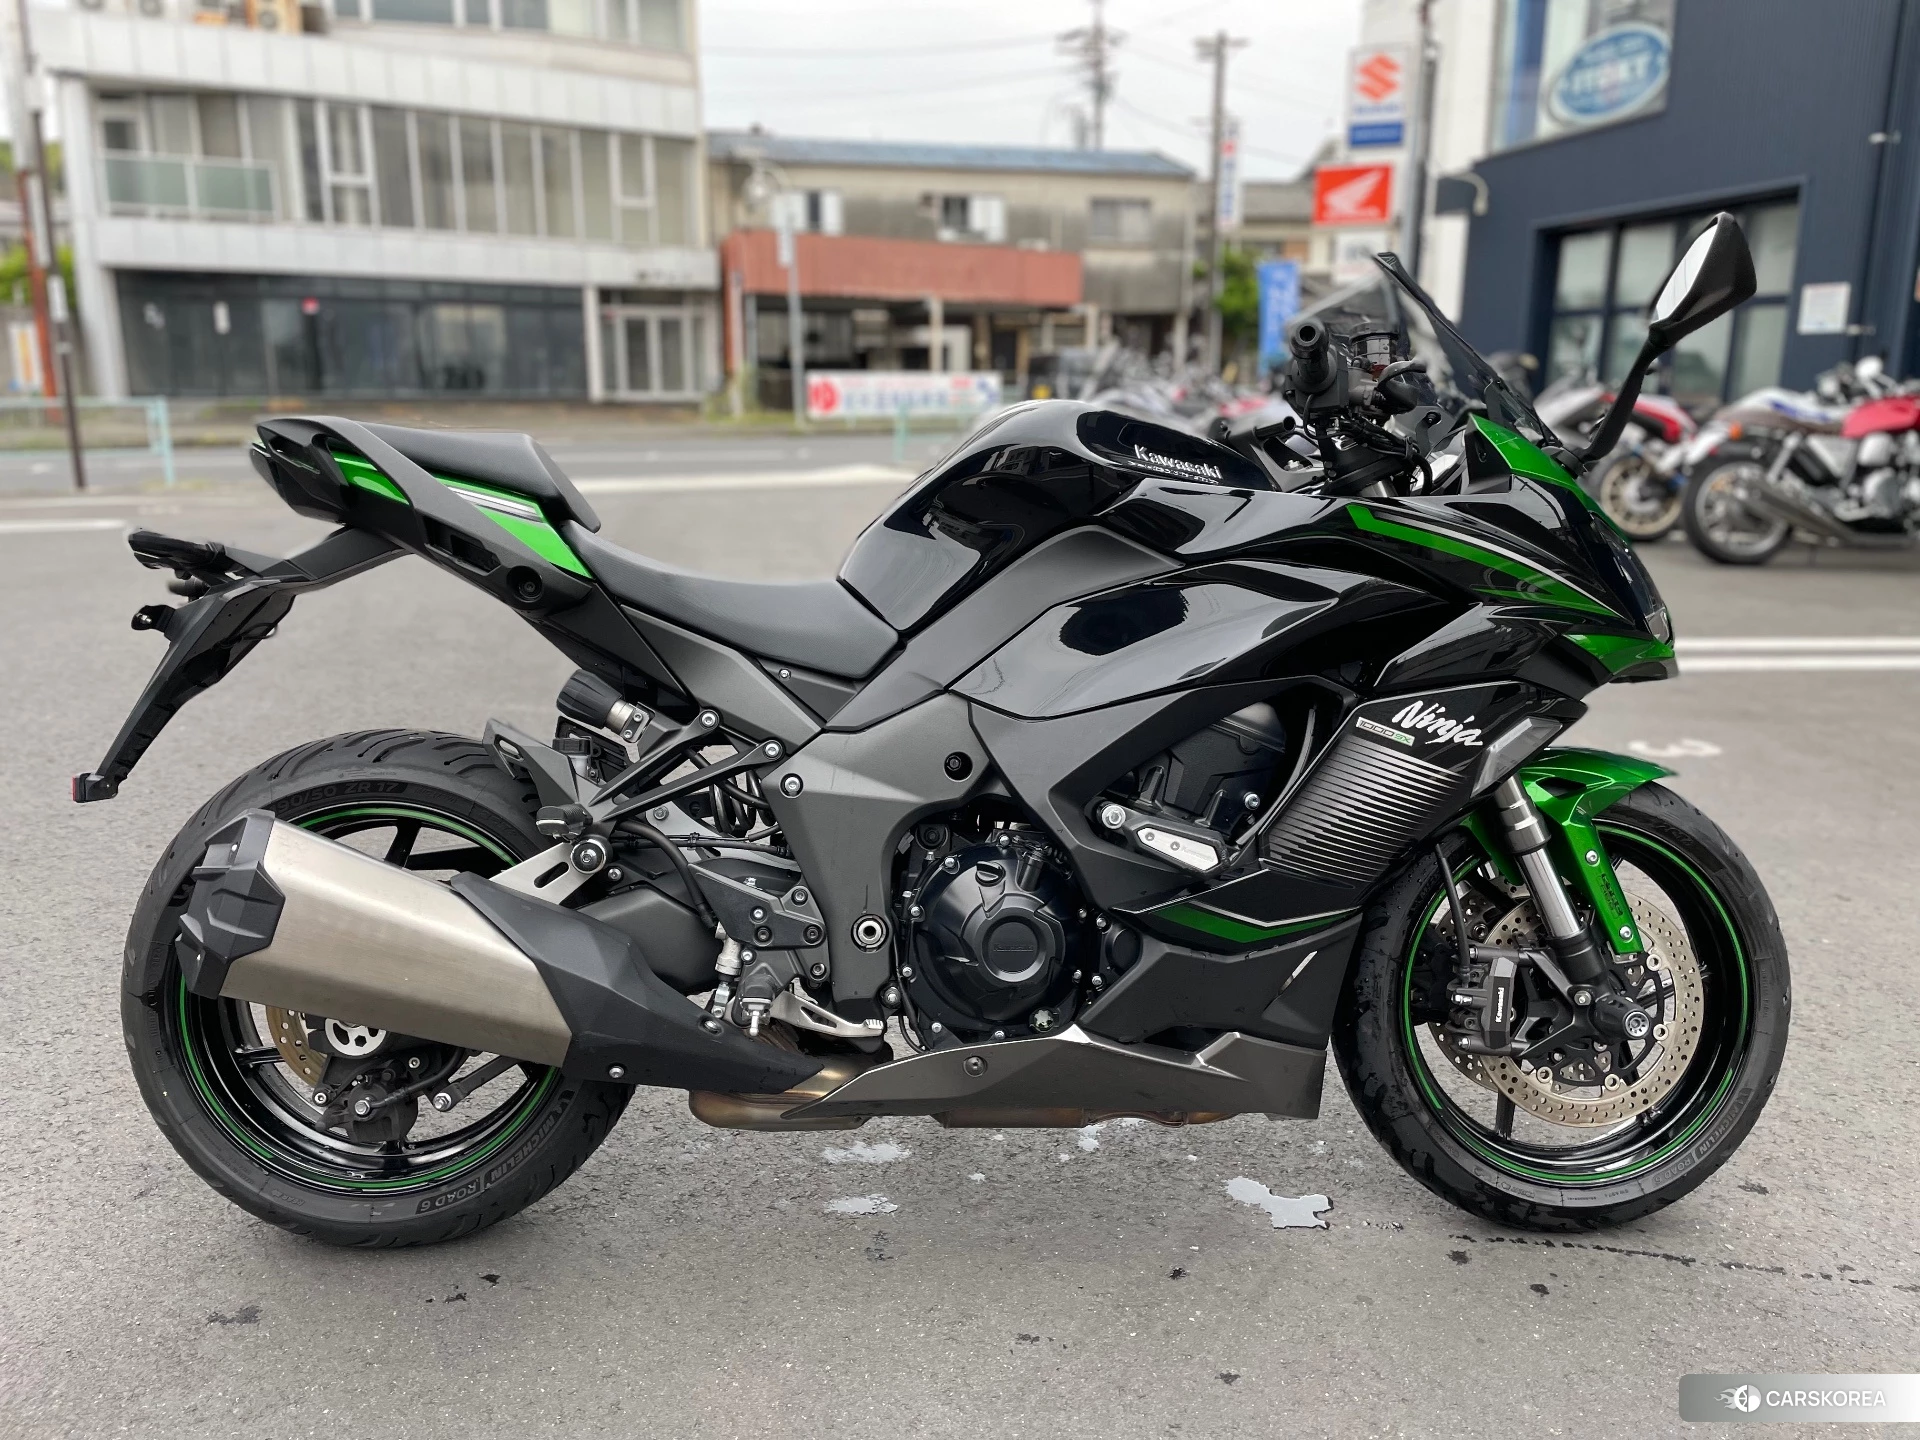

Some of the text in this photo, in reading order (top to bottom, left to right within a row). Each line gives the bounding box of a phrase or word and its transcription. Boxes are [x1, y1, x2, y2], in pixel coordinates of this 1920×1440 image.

[1134, 444, 1223, 479] Kawasaki
[1391, 700, 1483, 746] Ninja
[344, 782, 371, 794] ZR
[378, 782, 399, 793] 17
[1495, 987, 1505, 1023] Kawasaki
[1700, 1104, 1740, 1155] MICHELIN
[420, 1114, 556, 1212] MICHELIN ROAD 6
[1665, 1157, 1691, 1178] ROAD
